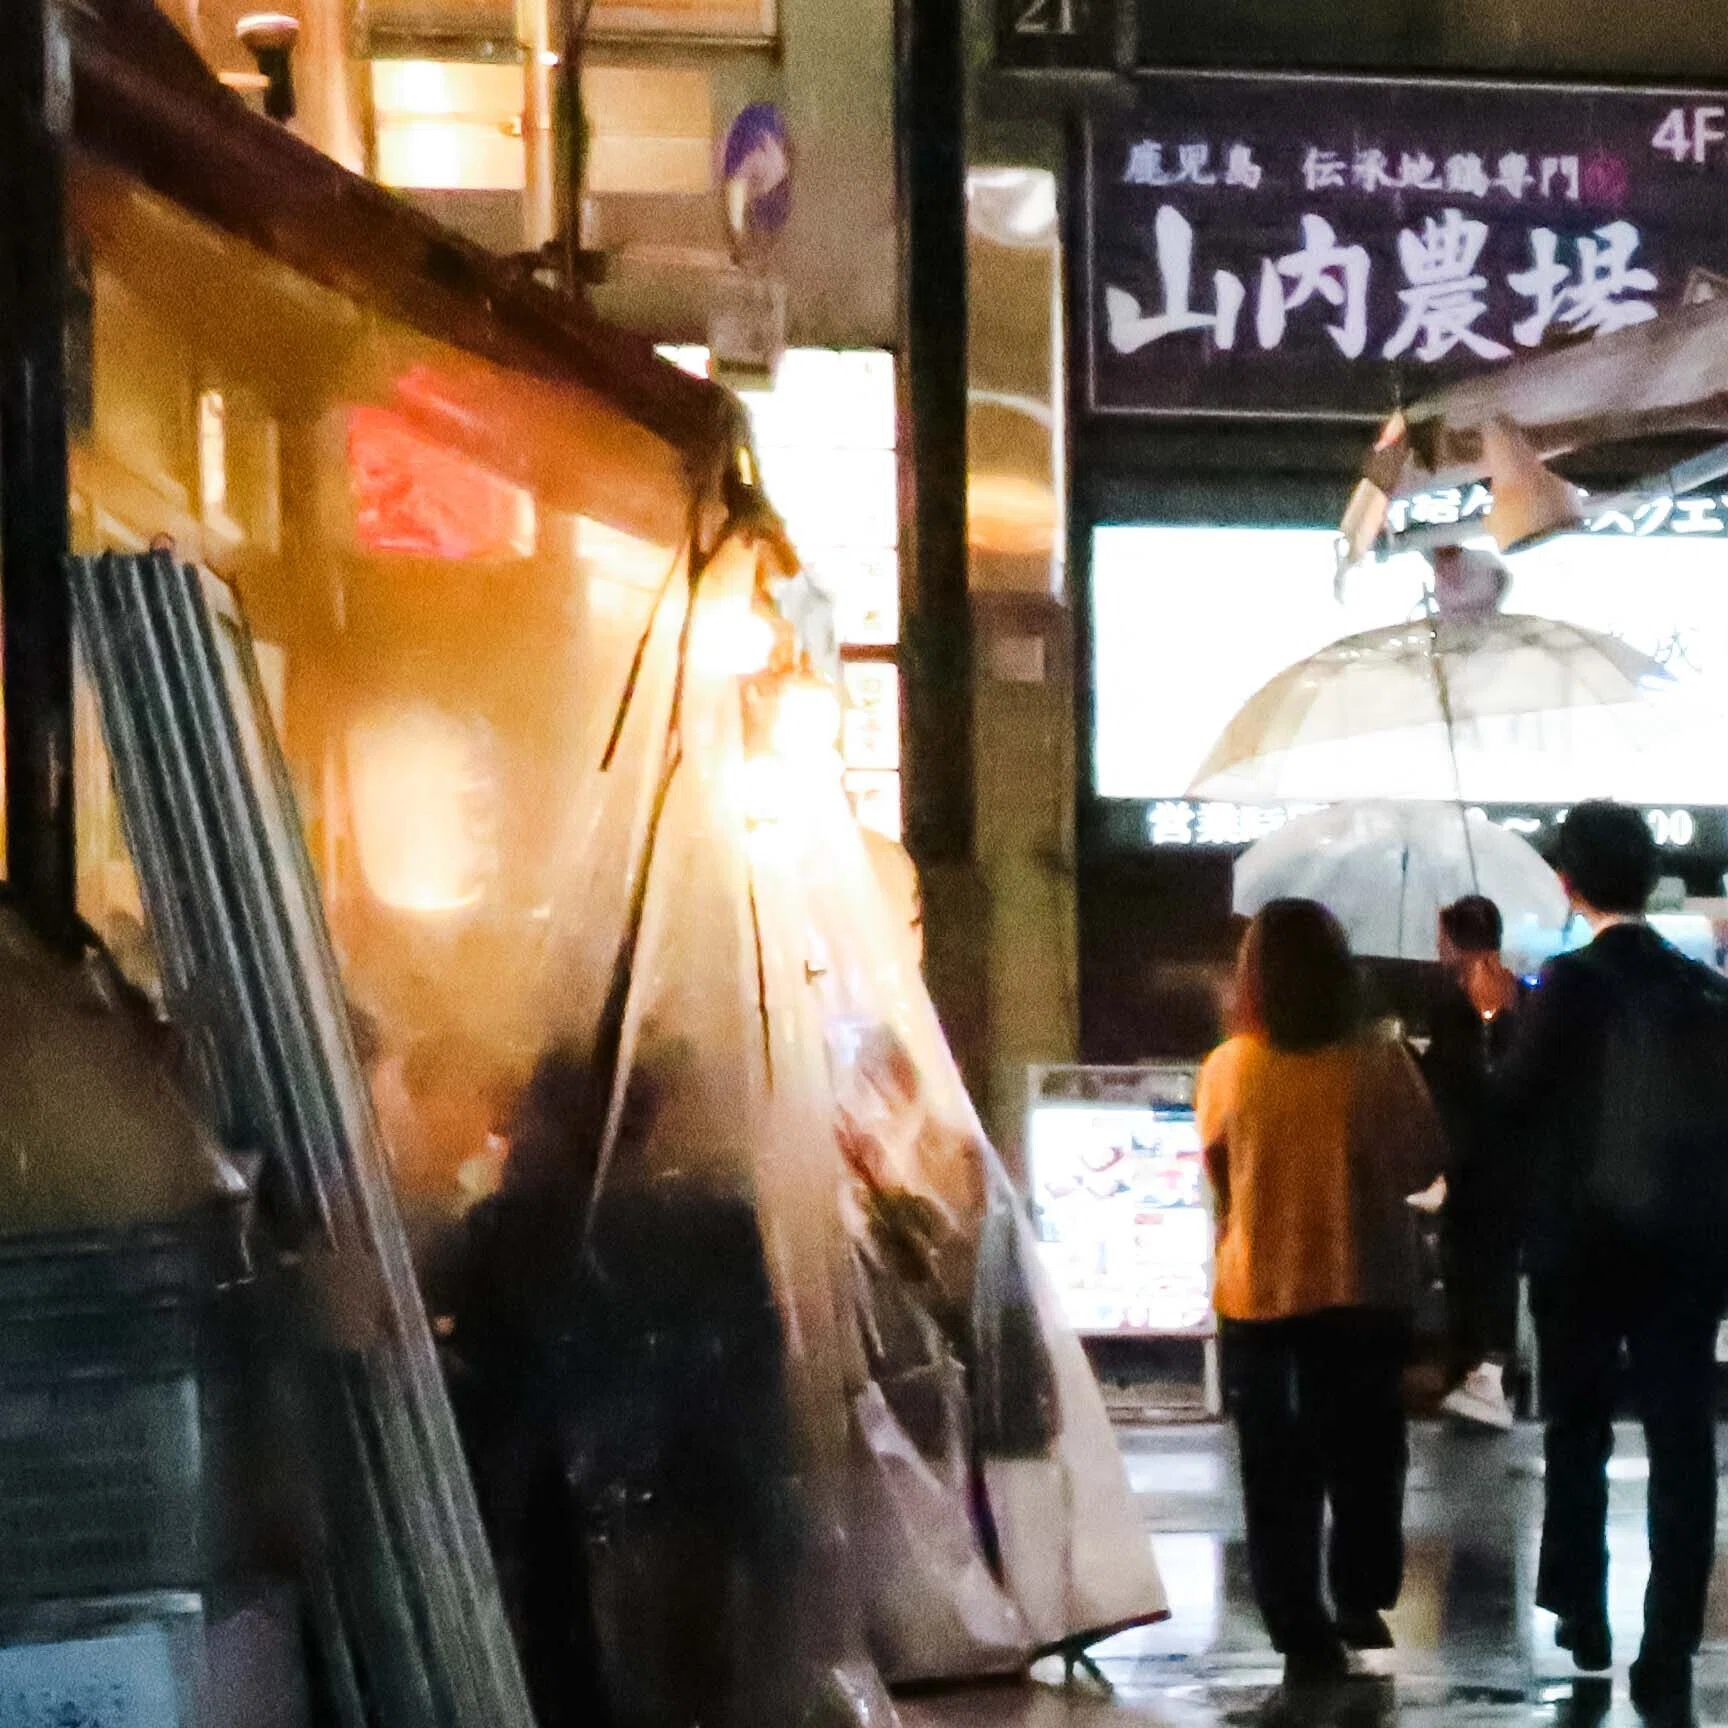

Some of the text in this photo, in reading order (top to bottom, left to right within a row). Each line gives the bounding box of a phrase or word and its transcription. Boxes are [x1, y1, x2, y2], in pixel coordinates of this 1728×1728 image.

[1651, 106, 1726, 163] 4F
[1123, 138, 1262, 190] 鹿児島
[1106, 205, 1659, 361] 山内農場
